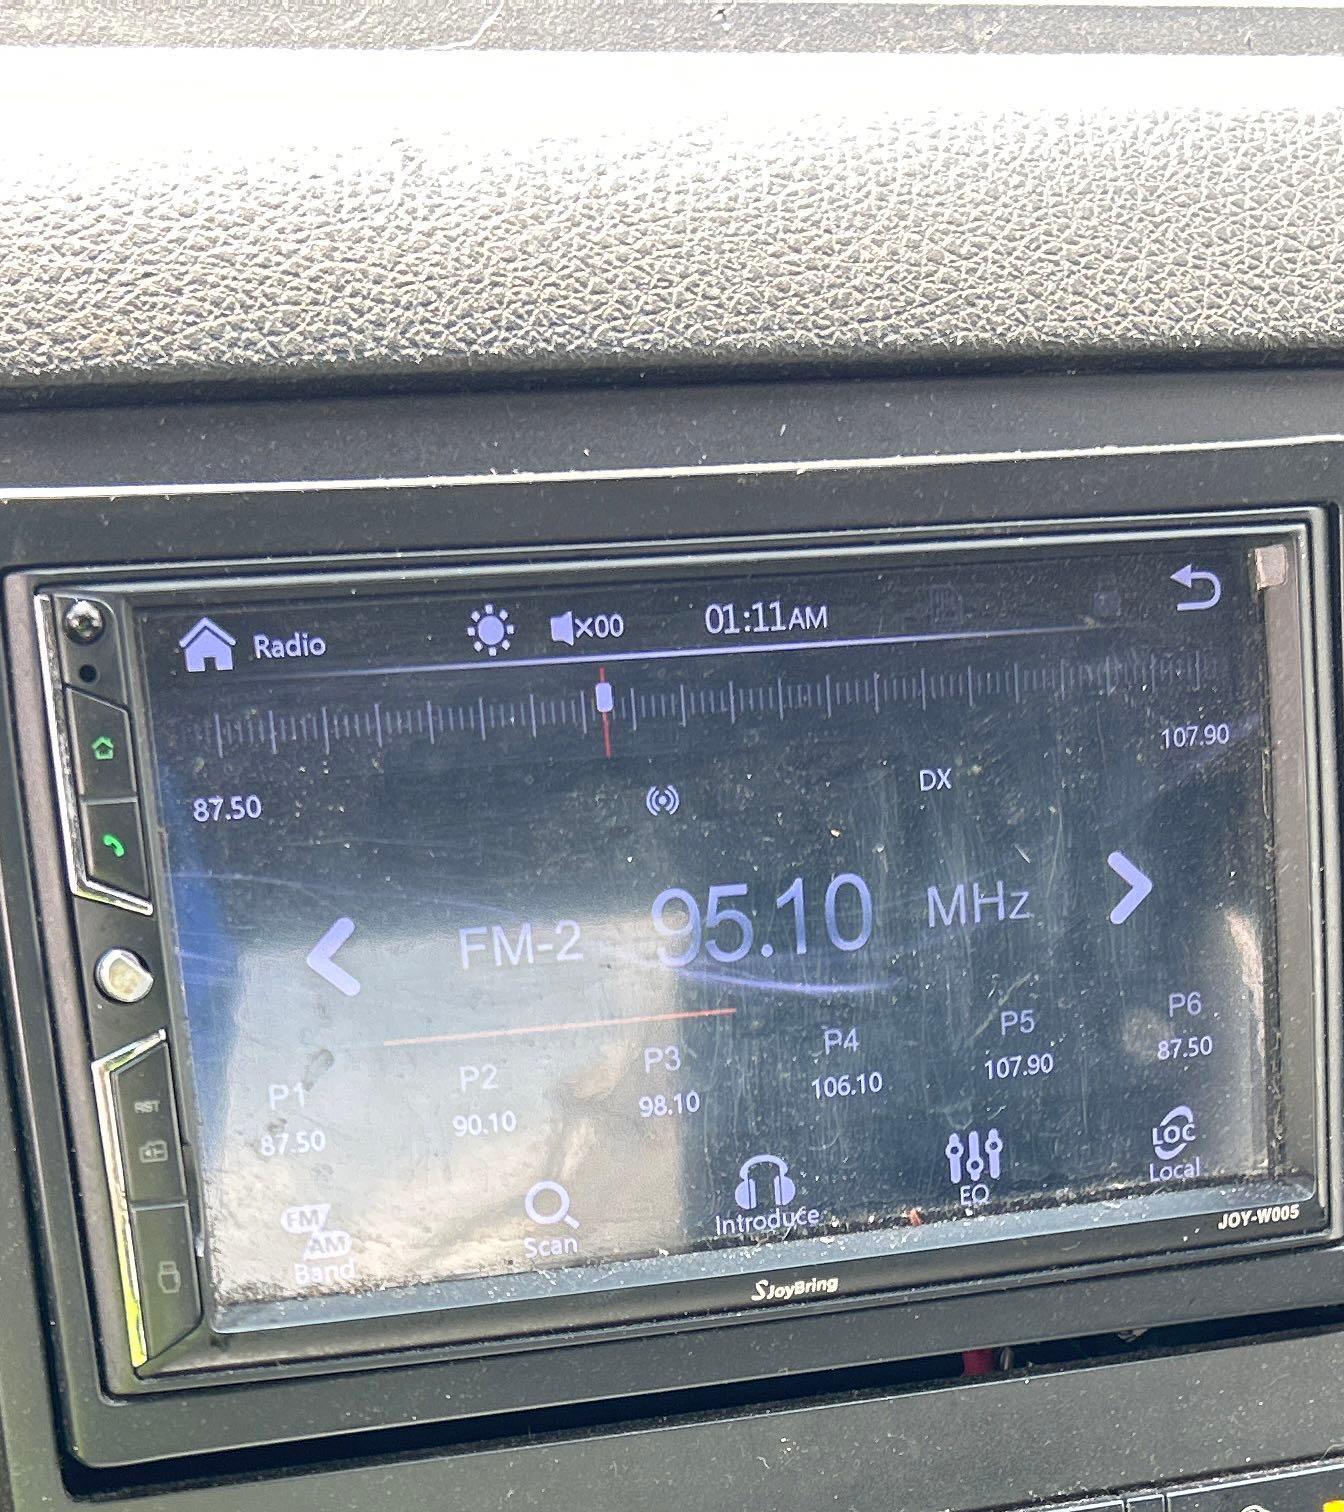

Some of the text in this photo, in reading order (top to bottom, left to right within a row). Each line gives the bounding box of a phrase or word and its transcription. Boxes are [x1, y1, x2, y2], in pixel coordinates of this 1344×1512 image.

[704, 600, 829, 635] 01:11AM
[253, 632, 327, 661] Radio
[1160, 722, 1230, 749] 107.90
[918, 767, 953, 793] DX
[191, 794, 263, 823] 87.50
[458, 872, 1032, 969] FM-2 95.10 MHz
[1168, 992, 1204, 1018] P6
[999, 1009, 1037, 1037] P5
[822, 1026, 861, 1056] P4
[1156, 1034, 1215, 1062] 87.50
[642, 1045, 682, 1074] P3
[984, 1051, 1056, 1083] 107.90
[459, 1064, 499, 1093] P2
[810, 1069, 884, 1101] 106.10
[268, 1082, 309, 1112] P1
[639, 1089, 702, 1119] 98.10
[452, 1110, 518, 1138] 90.10
[1152, 1122, 1197, 1147] LOC
[260, 1129, 327, 1157] 87.50
[1149, 1157, 1201, 1183] Local
[715, 1206, 820, 1236] Introduce
[1218, 1205, 1300, 1230] JOY-W005
[523, 1233, 580, 1260] Scan
